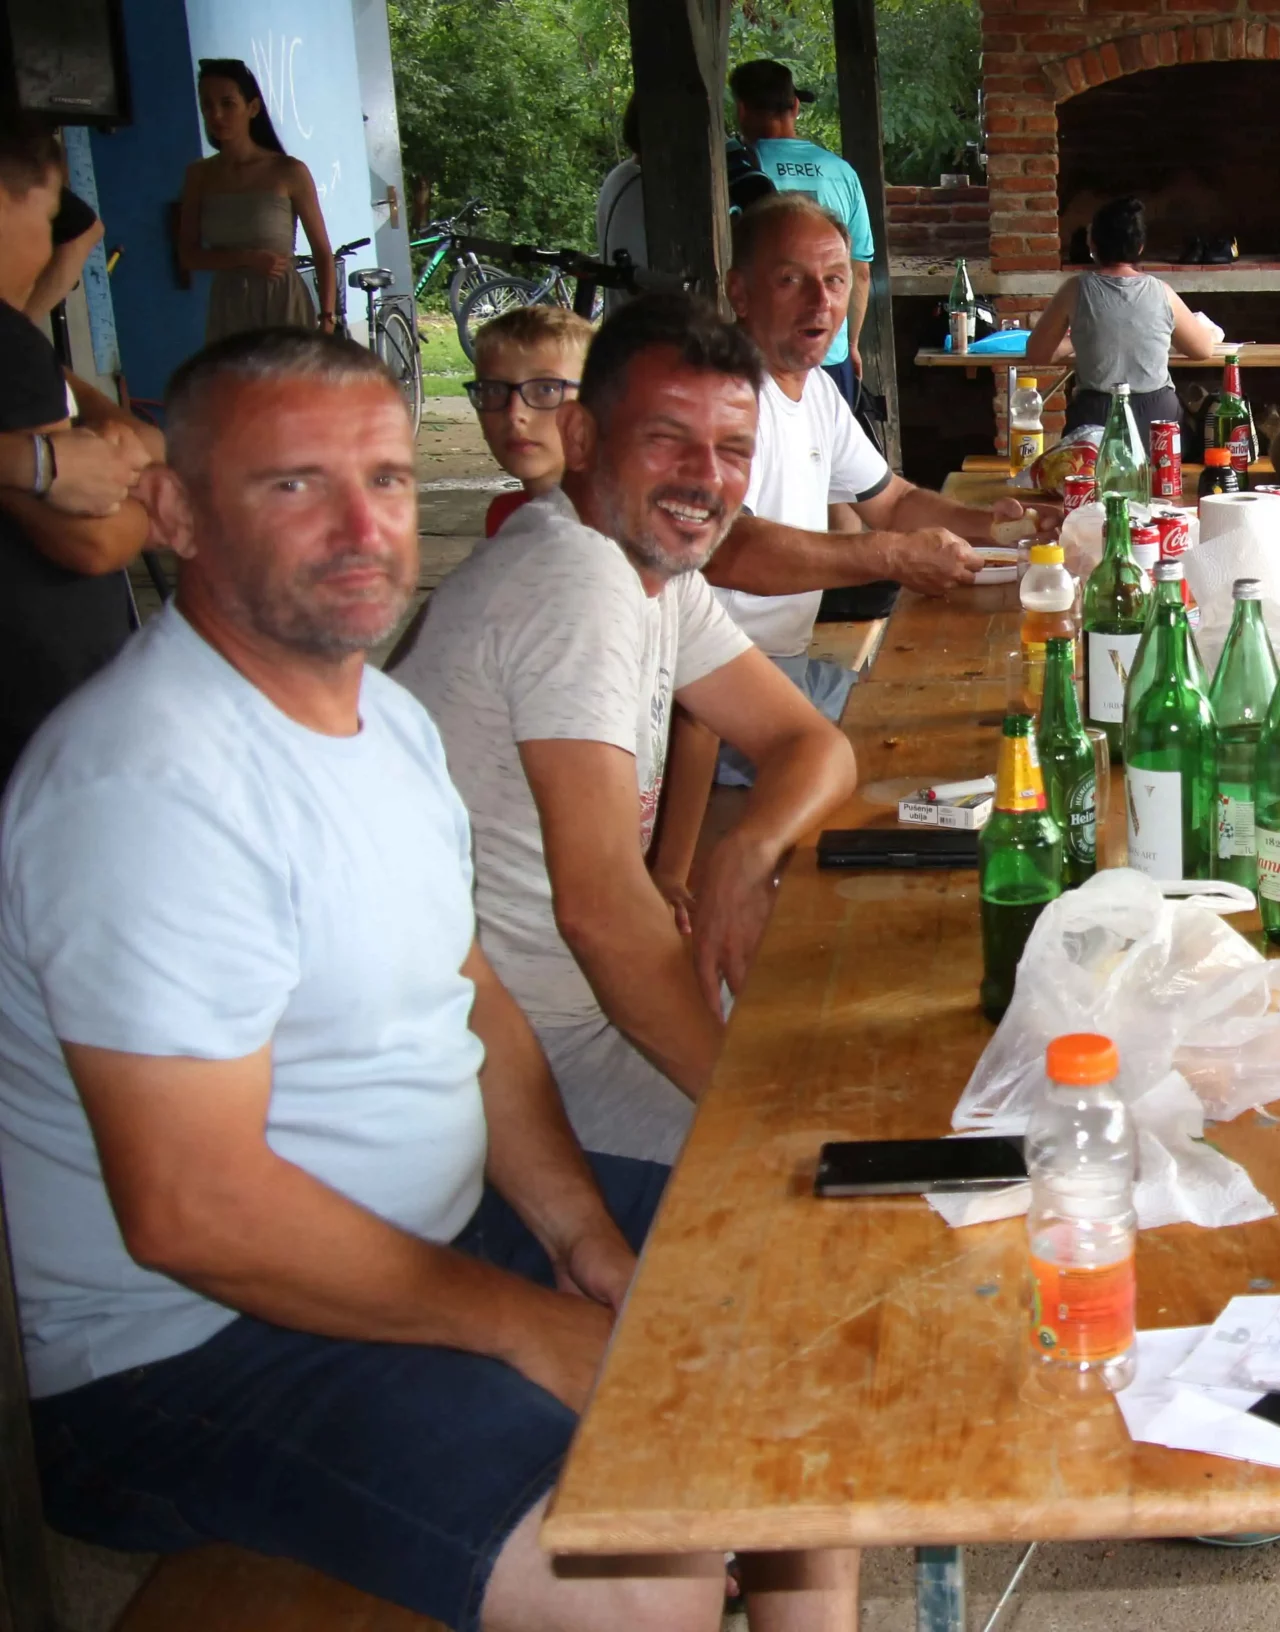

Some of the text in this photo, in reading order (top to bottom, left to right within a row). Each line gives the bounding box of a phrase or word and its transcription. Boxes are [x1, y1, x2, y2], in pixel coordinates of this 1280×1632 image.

[252, 28, 314, 139] WC
[776, 162, 824, 177] BEREK
[903, 803, 933, 814] Pušenje
[909, 813, 928, 822] ubija
[1140, 851, 1157, 860] ART
